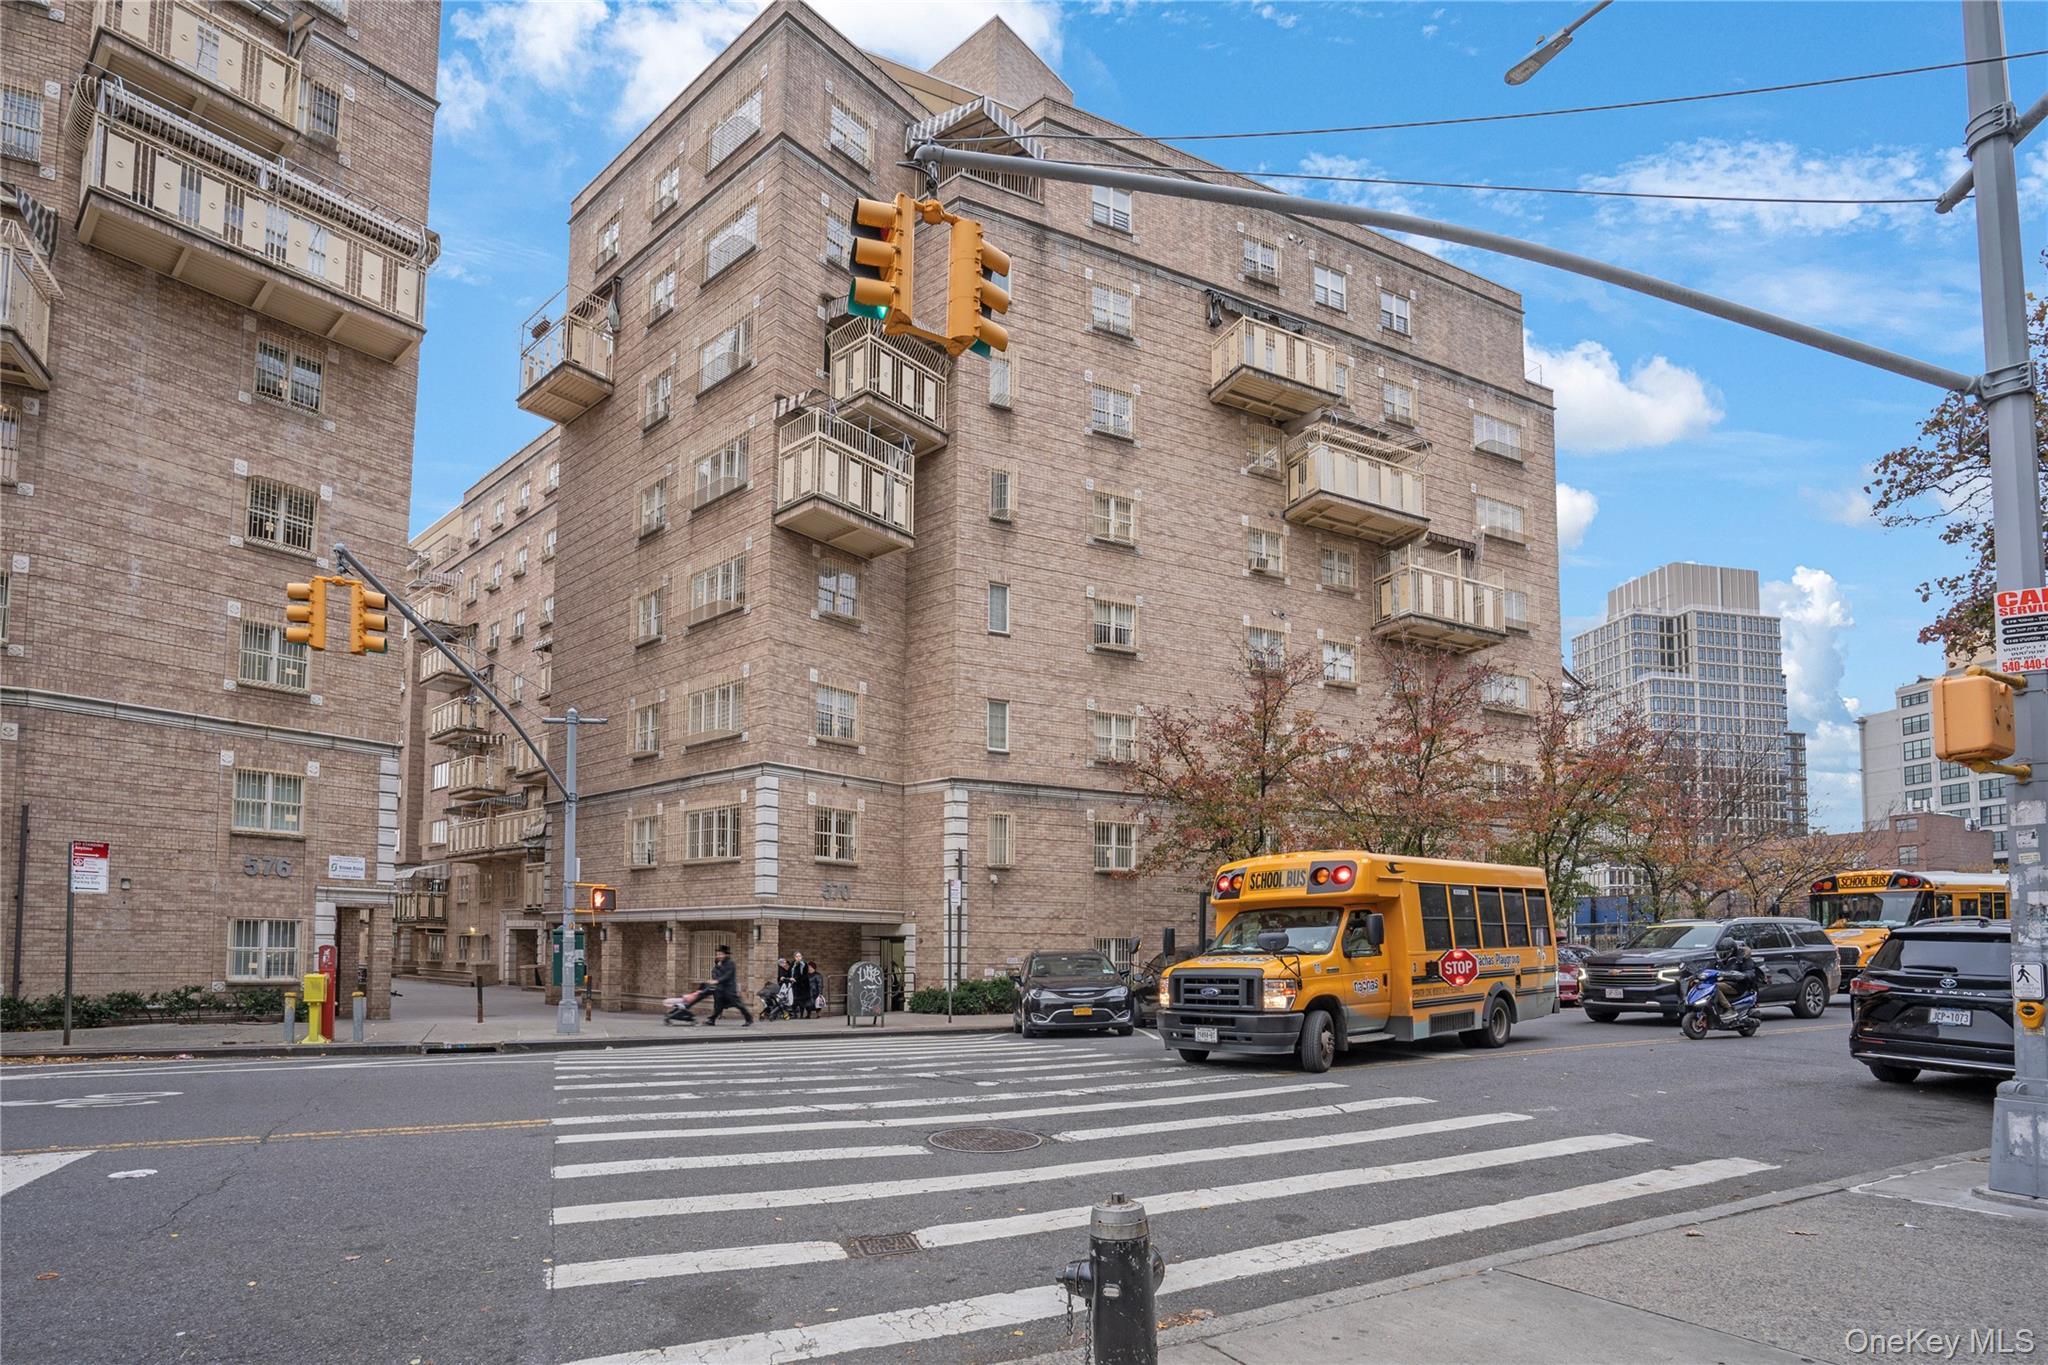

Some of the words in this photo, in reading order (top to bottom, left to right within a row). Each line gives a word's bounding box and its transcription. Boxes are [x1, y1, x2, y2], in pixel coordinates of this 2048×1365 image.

[244, 855, 292, 877] 576
[1250, 871, 1284, 889] SCHOOL
[1287, 869, 1306, 887] BUS
[1840, 876, 1868, 887] SCHOOL
[1871, 875, 1887, 886] BUS
[1445, 960, 1473, 975] STOP
[1914, 988, 1986, 997] SIENNA
[1932, 1011, 1969, 1023] JCP-1073
